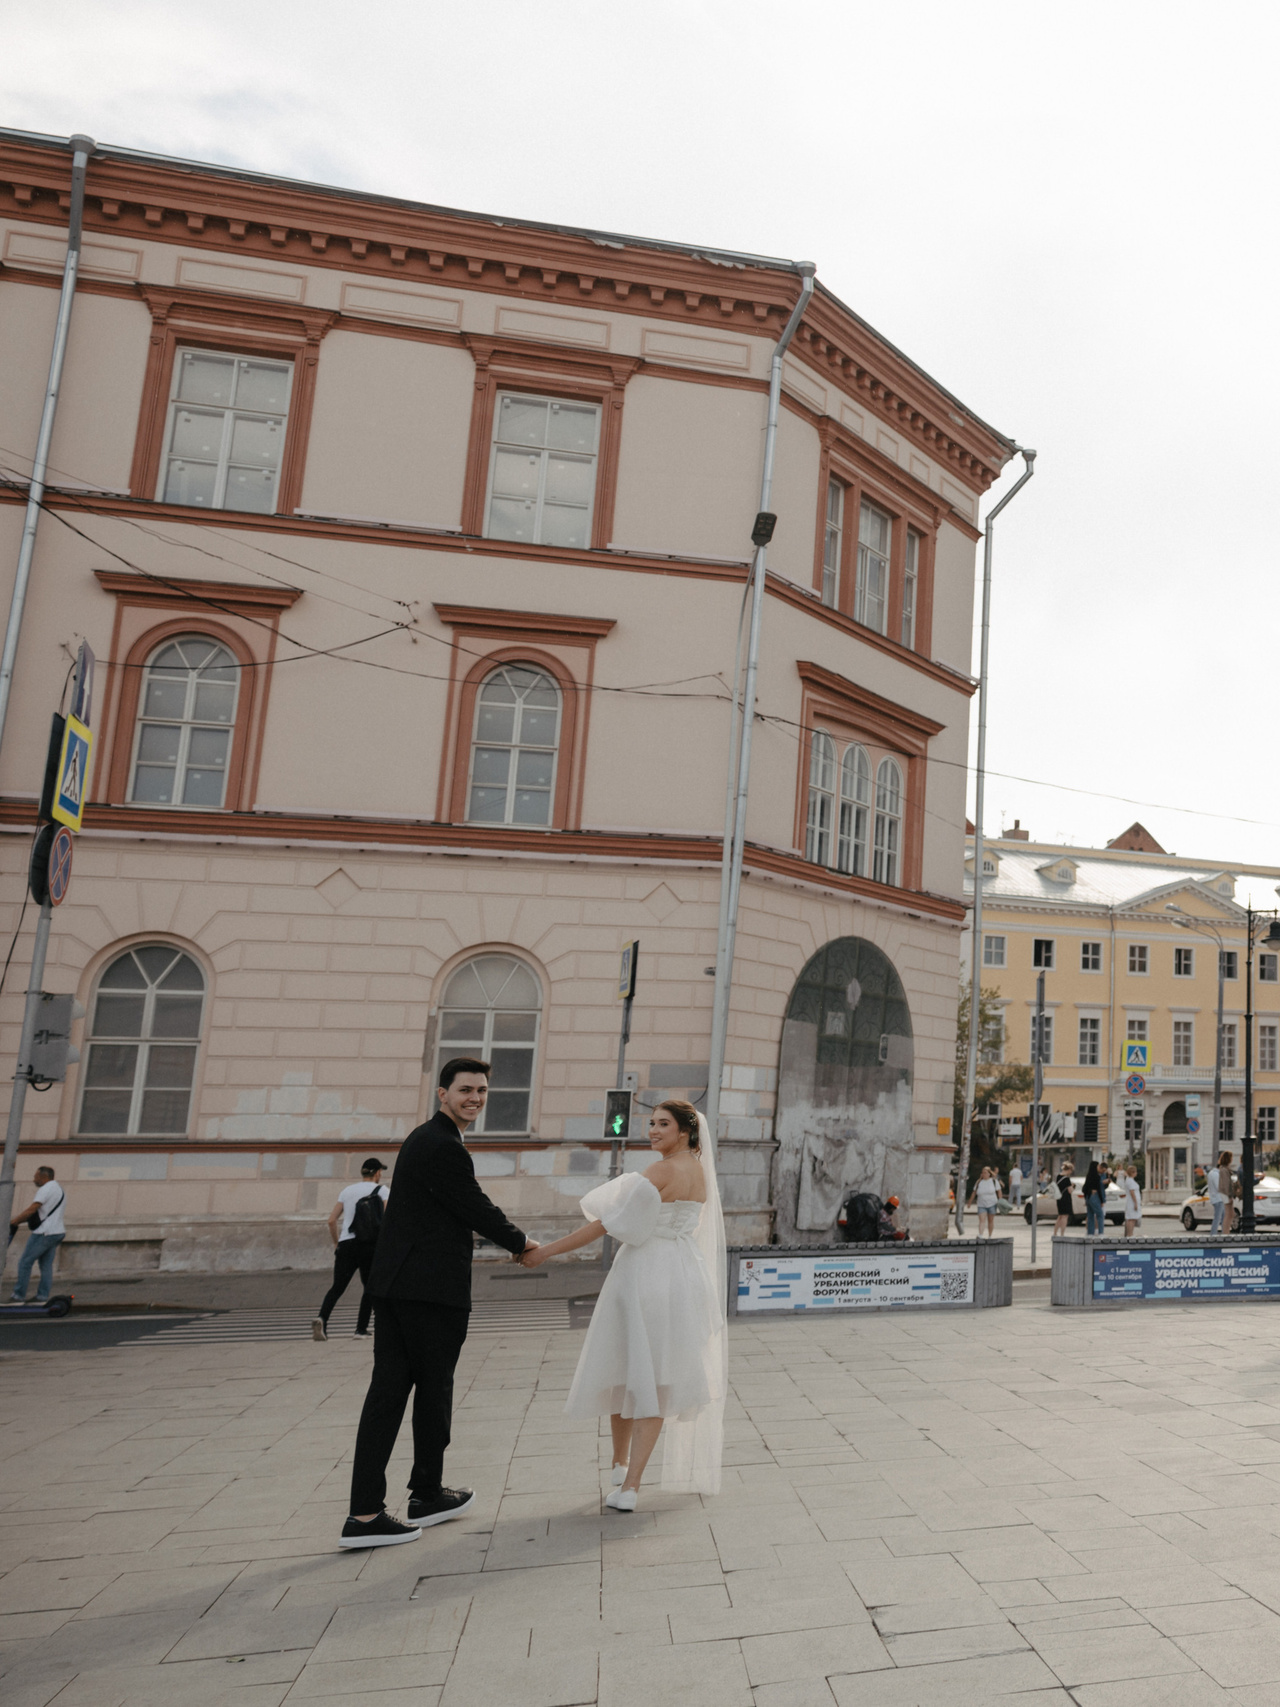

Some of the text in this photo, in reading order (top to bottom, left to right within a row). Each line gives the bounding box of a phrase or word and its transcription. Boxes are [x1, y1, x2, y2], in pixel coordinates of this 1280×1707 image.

[1155, 1255, 1234, 1268] МОСКОВСКИЙ
[813, 1268, 880, 1279] МОСКОВСКИЙ
[1155, 1265, 1269, 1279] УРБАНИСТИЧЕСКИЙ
[813, 1276, 910, 1288] УРБАНИСТИЧЕСКИЙ
[1155, 1279, 1198, 1290] ФОРУМ
[812, 1288, 849, 1296] ФОРУМ
[842, 1296, 872, 1305] августа
[889, 1294, 924, 1302] сентября
